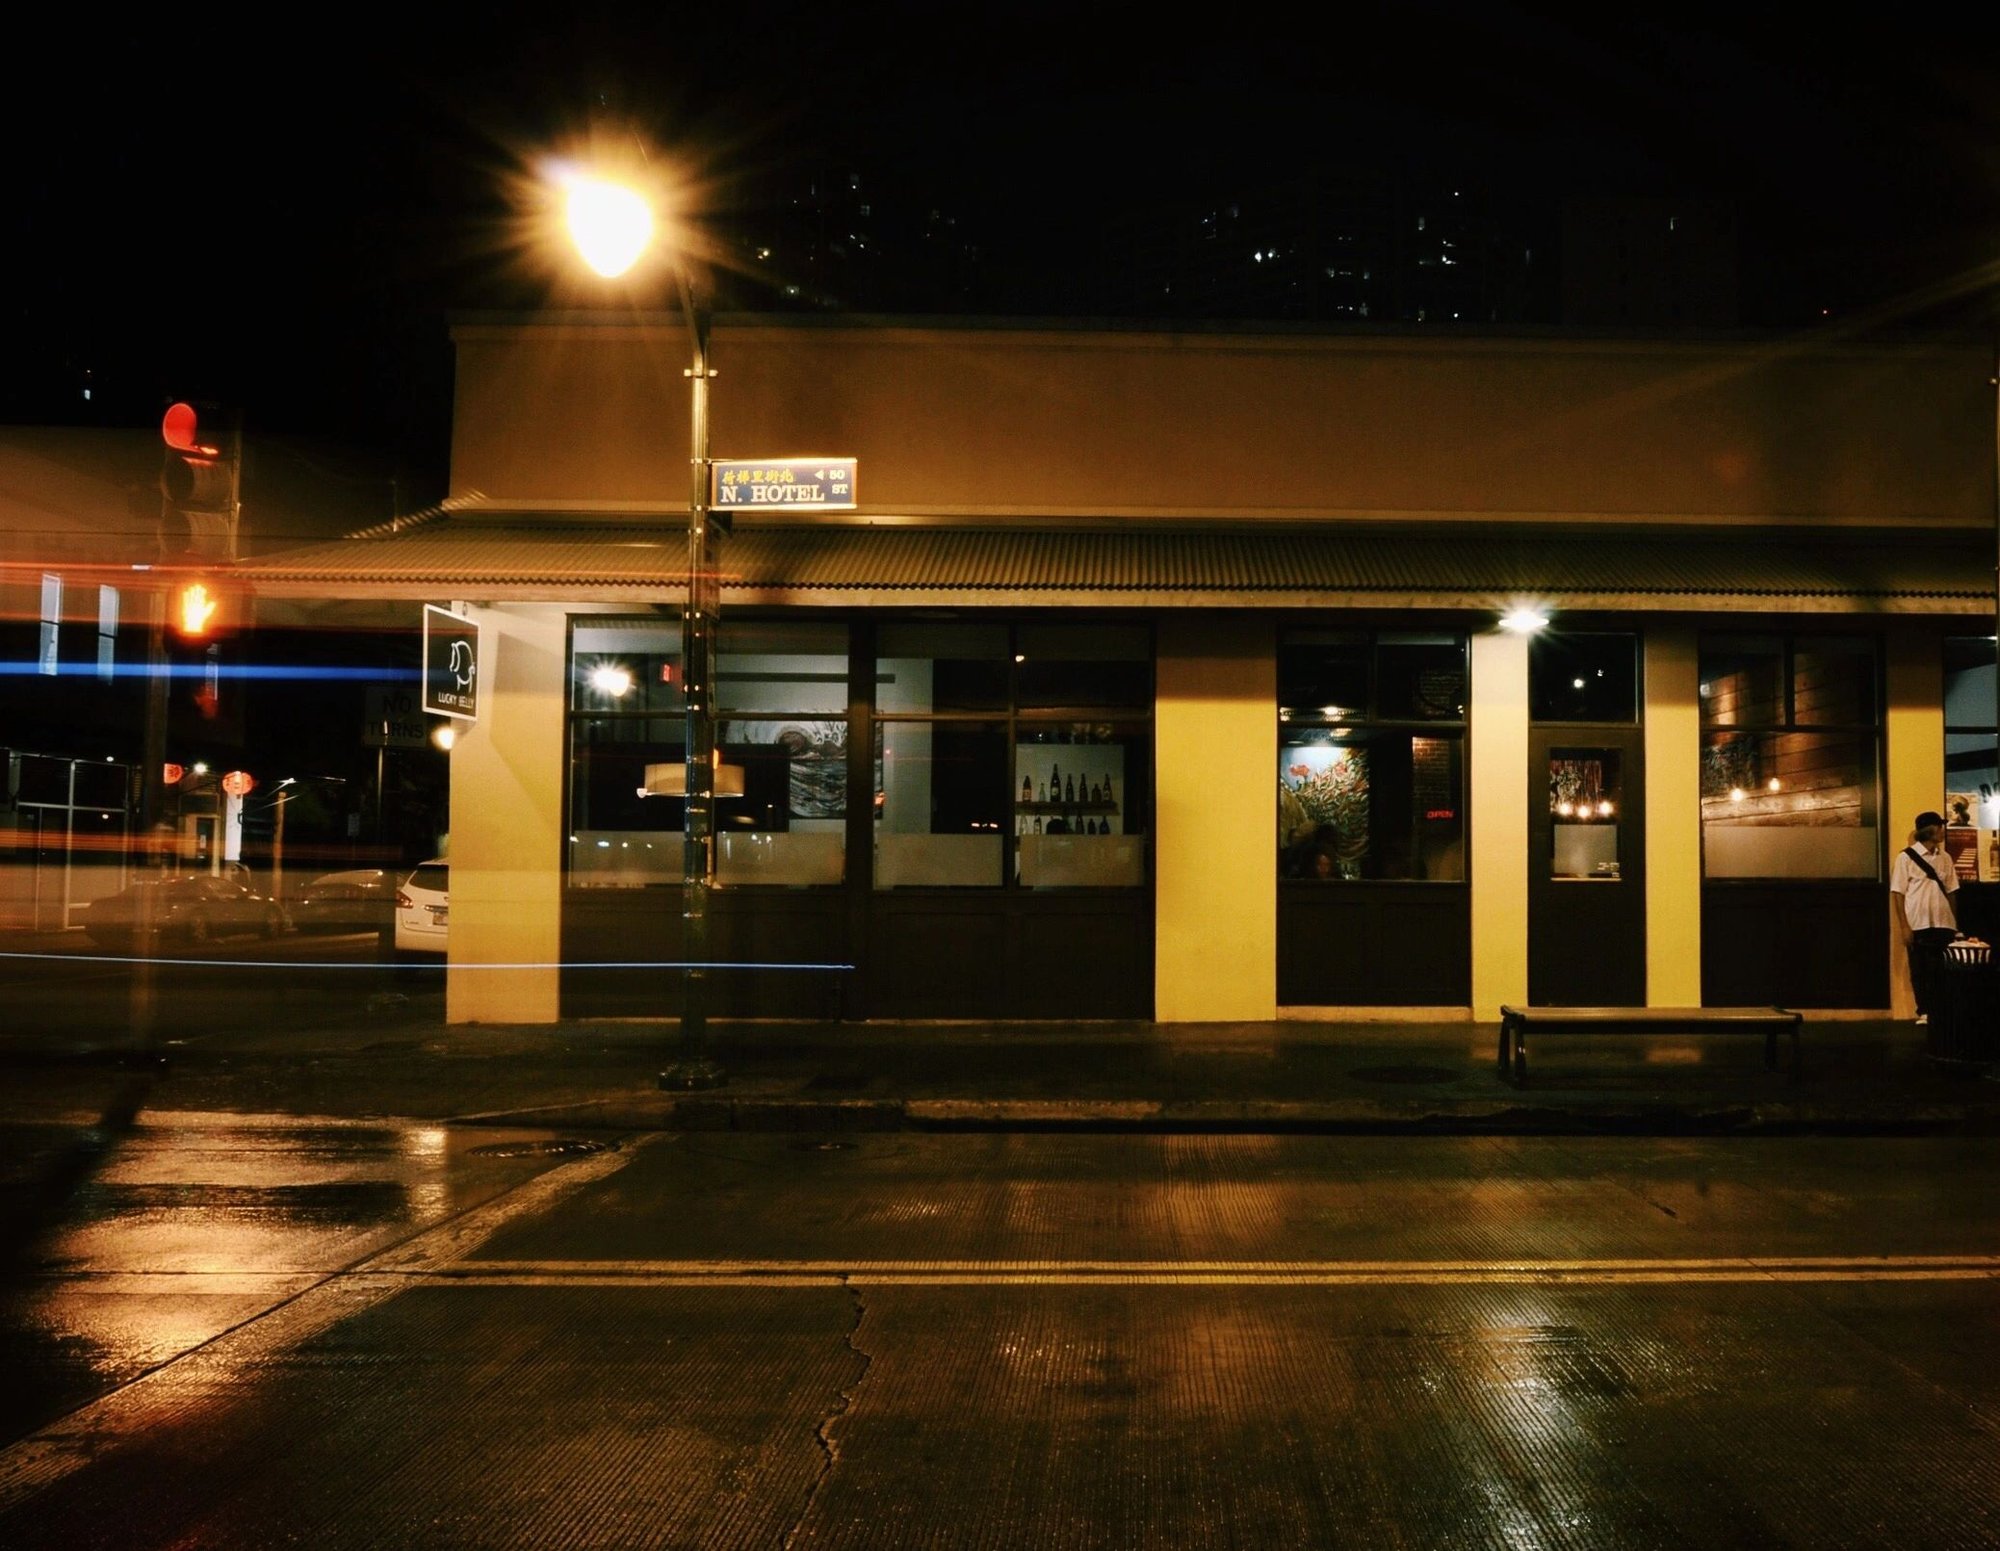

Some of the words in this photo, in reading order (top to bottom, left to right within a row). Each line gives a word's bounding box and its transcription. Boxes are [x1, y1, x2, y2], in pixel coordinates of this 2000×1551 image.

[721, 486, 743, 502] N.
[751, 485, 825, 502] HOTEL
[832, 484, 848, 494] ST
[383, 695, 412, 713] NO
[438, 691, 458, 705] LUCKY
[458, 696, 474, 708] BELLY
